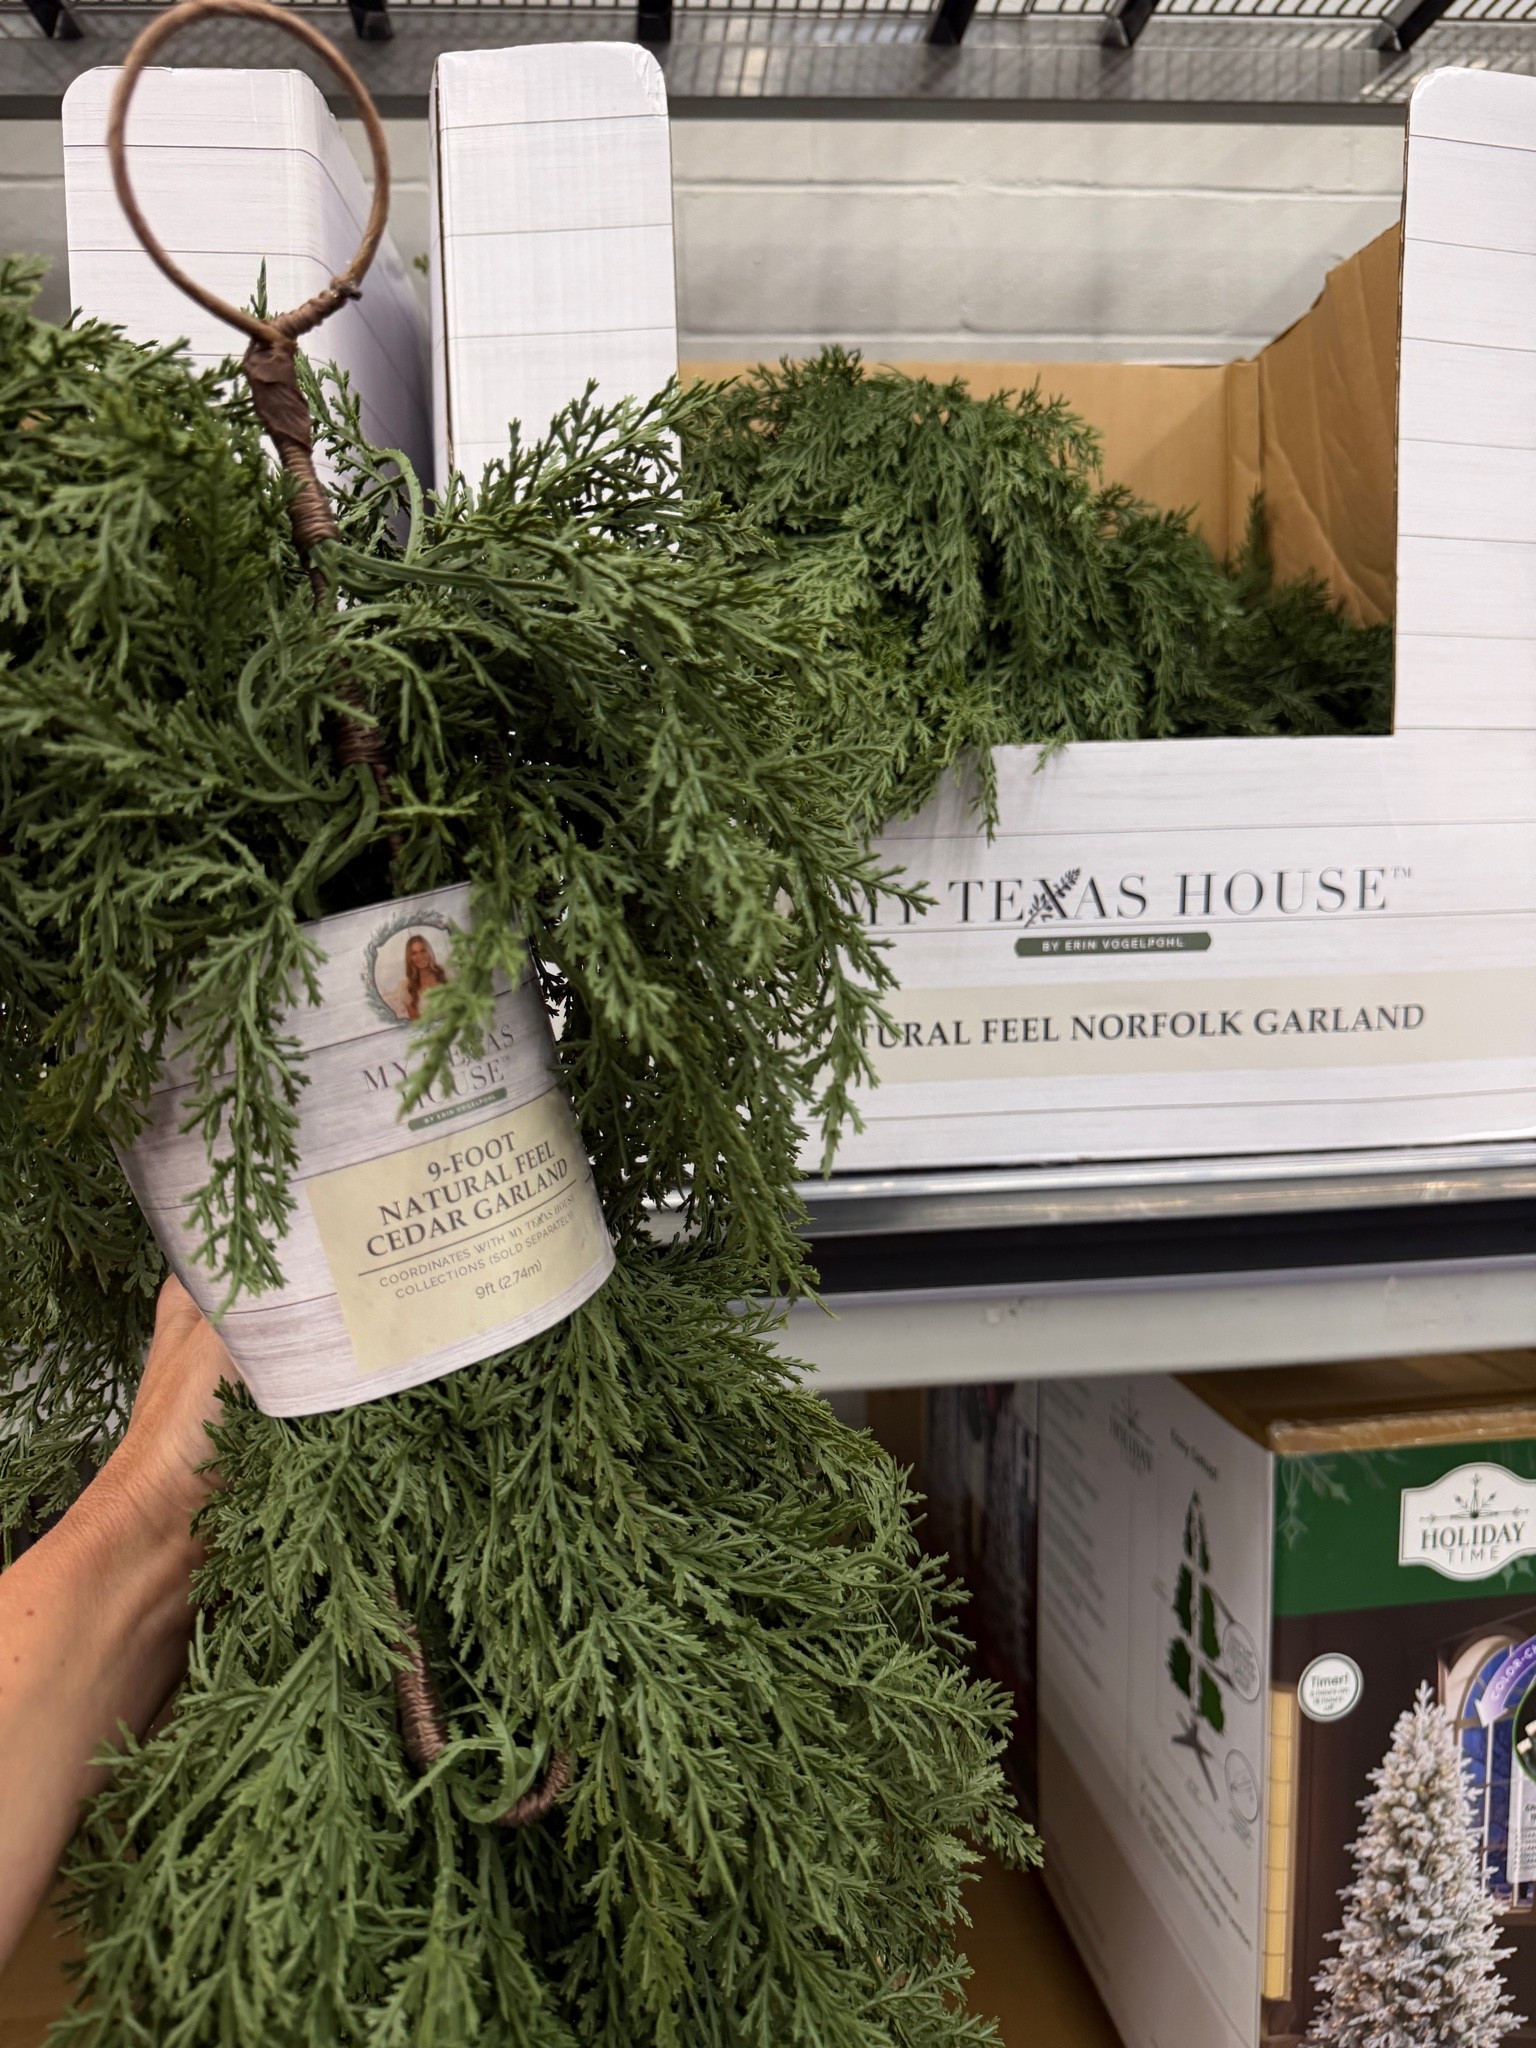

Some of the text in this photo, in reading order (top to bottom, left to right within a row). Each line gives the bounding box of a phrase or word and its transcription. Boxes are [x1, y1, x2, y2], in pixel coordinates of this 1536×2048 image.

[948, 868, 1148, 927] TEXAS
[1041, 935, 1185, 952] BY ERIN VOGELPOHL
[859, 1003, 1425, 1049] TURAL FEEL NORFOLK GARLAND
[427, 1131, 516, 1182] 9-FOOT
[366, 1157, 568, 1257] CEDAR GARLAND
[377, 1140, 556, 1226] NATURAL FEEL
[380, 1247, 472, 1288] COORDINATES
[473, 1233, 506, 1254] WITH
[395, 1259, 487, 1299] COLLECTIONS
[488, 1241, 524, 1267] (SOLD
[475, 1258, 543, 1300] 9ft (2.74m)
[1420, 1520, 1526, 1550] HOLIDAY
[1446, 1544, 1500, 1565] TIME
